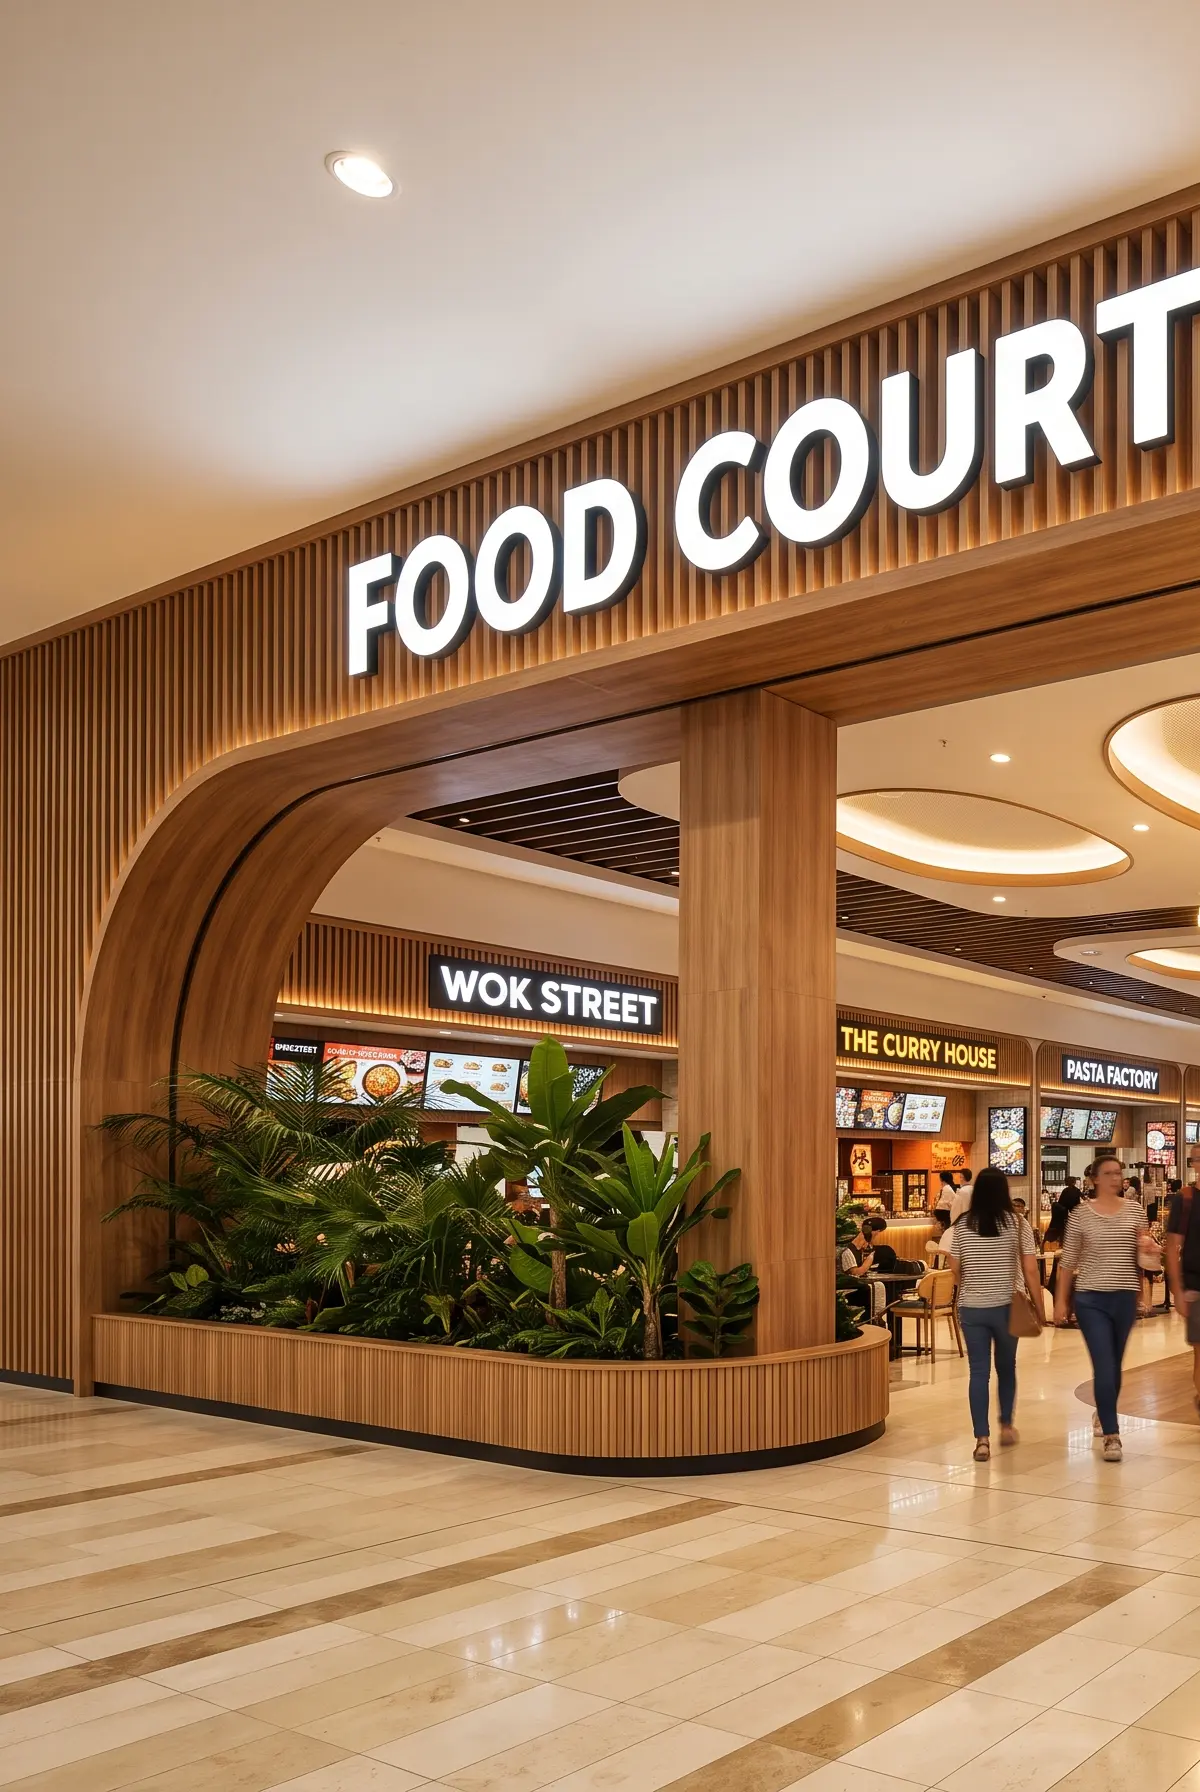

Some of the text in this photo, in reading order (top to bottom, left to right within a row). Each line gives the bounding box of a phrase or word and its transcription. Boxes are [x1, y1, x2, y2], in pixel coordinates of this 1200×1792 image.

[348, 478, 640, 676] FOOD
[440, 965, 658, 1026] WOK STREET
[840, 1026, 997, 1070] THE CURRY HOUSE
[1067, 1059, 1158, 1090] PASTA FACTORY
